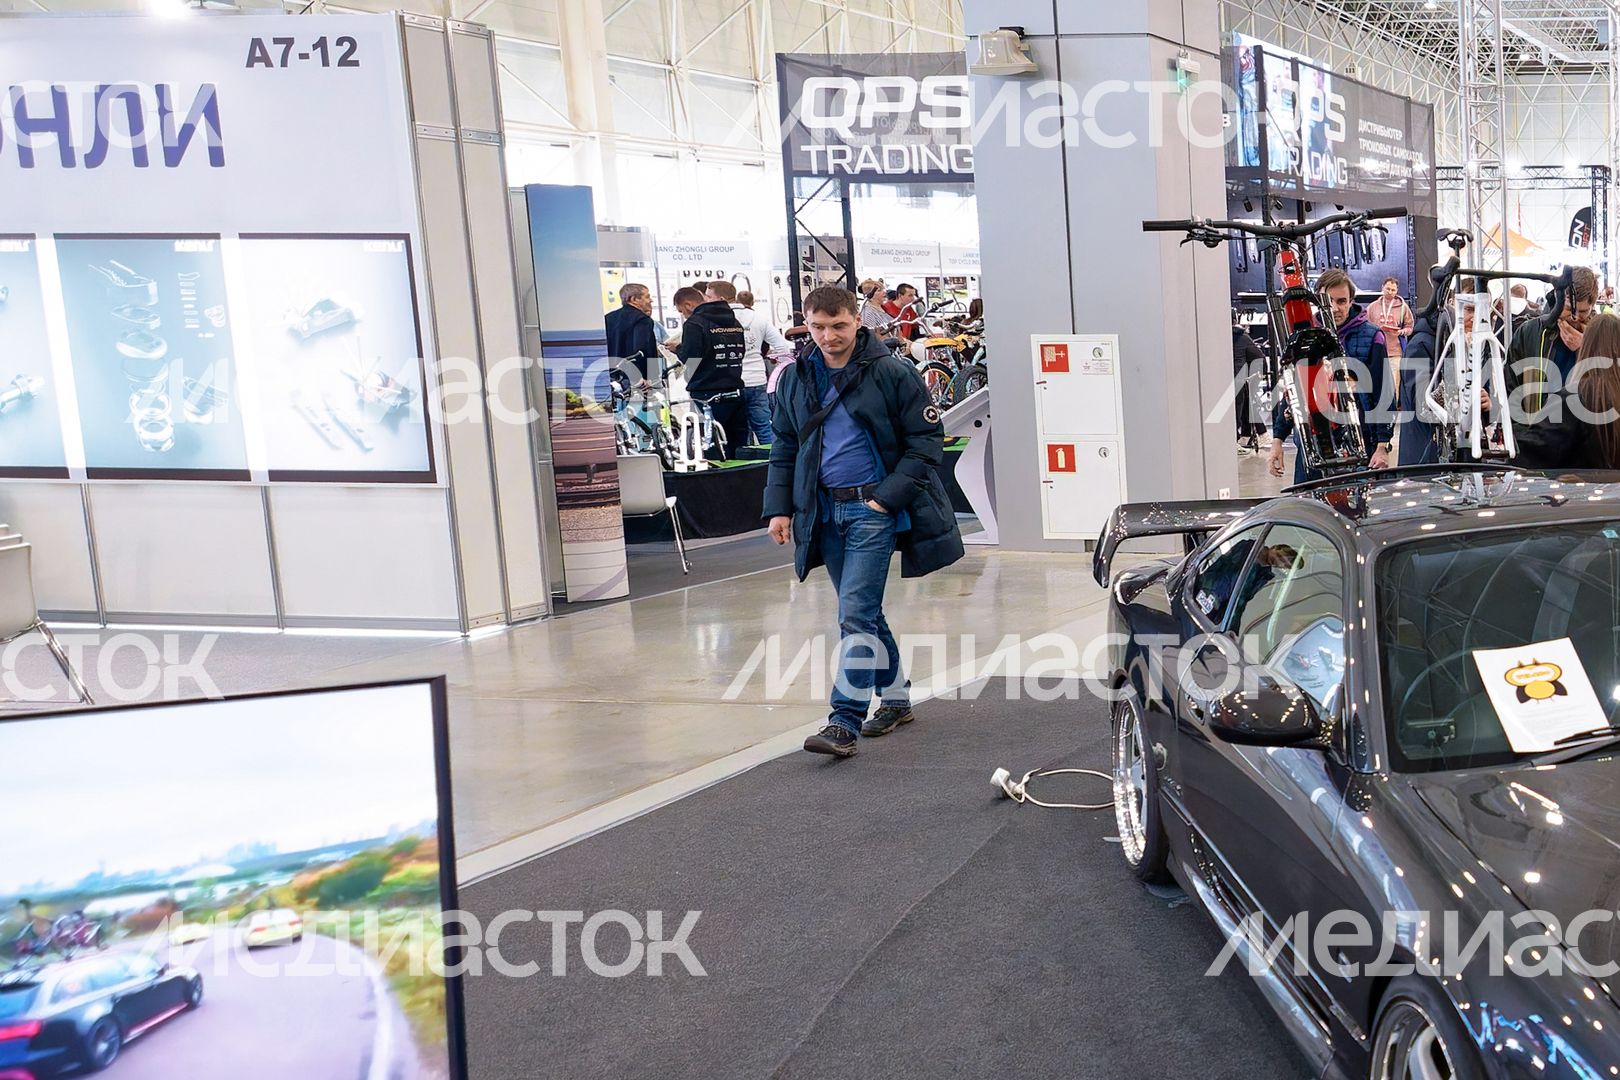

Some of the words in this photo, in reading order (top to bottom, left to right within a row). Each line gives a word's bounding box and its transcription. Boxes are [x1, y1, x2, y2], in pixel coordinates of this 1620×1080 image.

[245, 35, 360, 69] A7-12
[0, 83, 225, 169] НЛИ
[801, 75, 972, 138] QPS
[801, 144, 975, 175] TRADING
